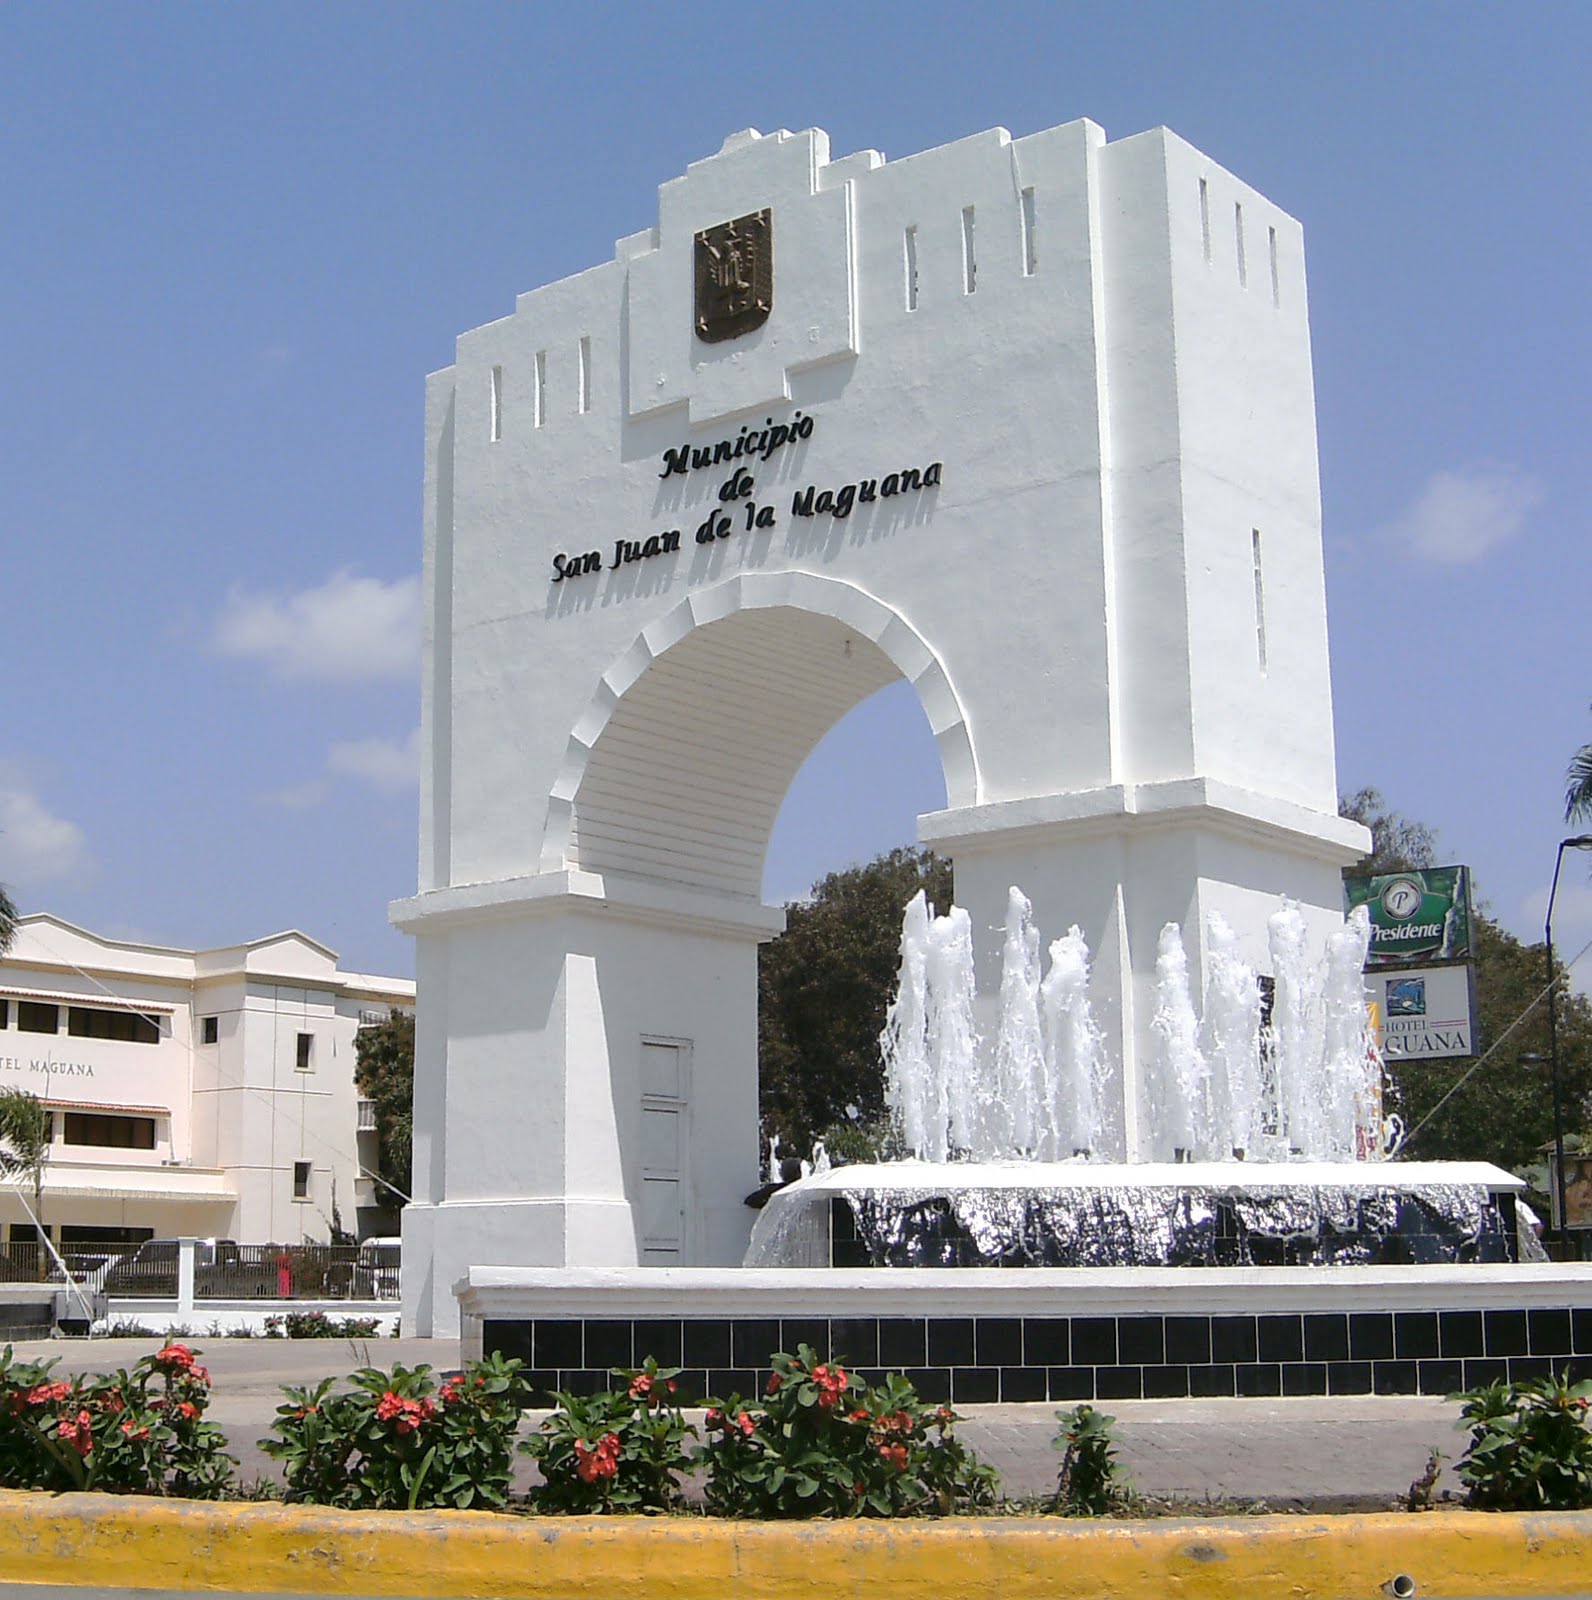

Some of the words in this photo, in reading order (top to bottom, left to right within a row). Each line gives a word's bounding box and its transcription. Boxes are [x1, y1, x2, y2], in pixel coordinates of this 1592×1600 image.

[658, 411, 814, 479] Municipio
[718, 467, 754, 501] de
[551, 550, 602, 582] San
[607, 528, 681, 570] Juan
[695, 508, 731, 544] de
[746, 501, 776, 531] la
[791, 461, 943, 518] Maguana
[1370, 922, 1441, 942] Presidente
[1385, 1020, 1427, 1033] HOTEL
[1382, 1031, 1468, 1055] GUANA
[29, 1060, 94, 1077] MAGUANA
